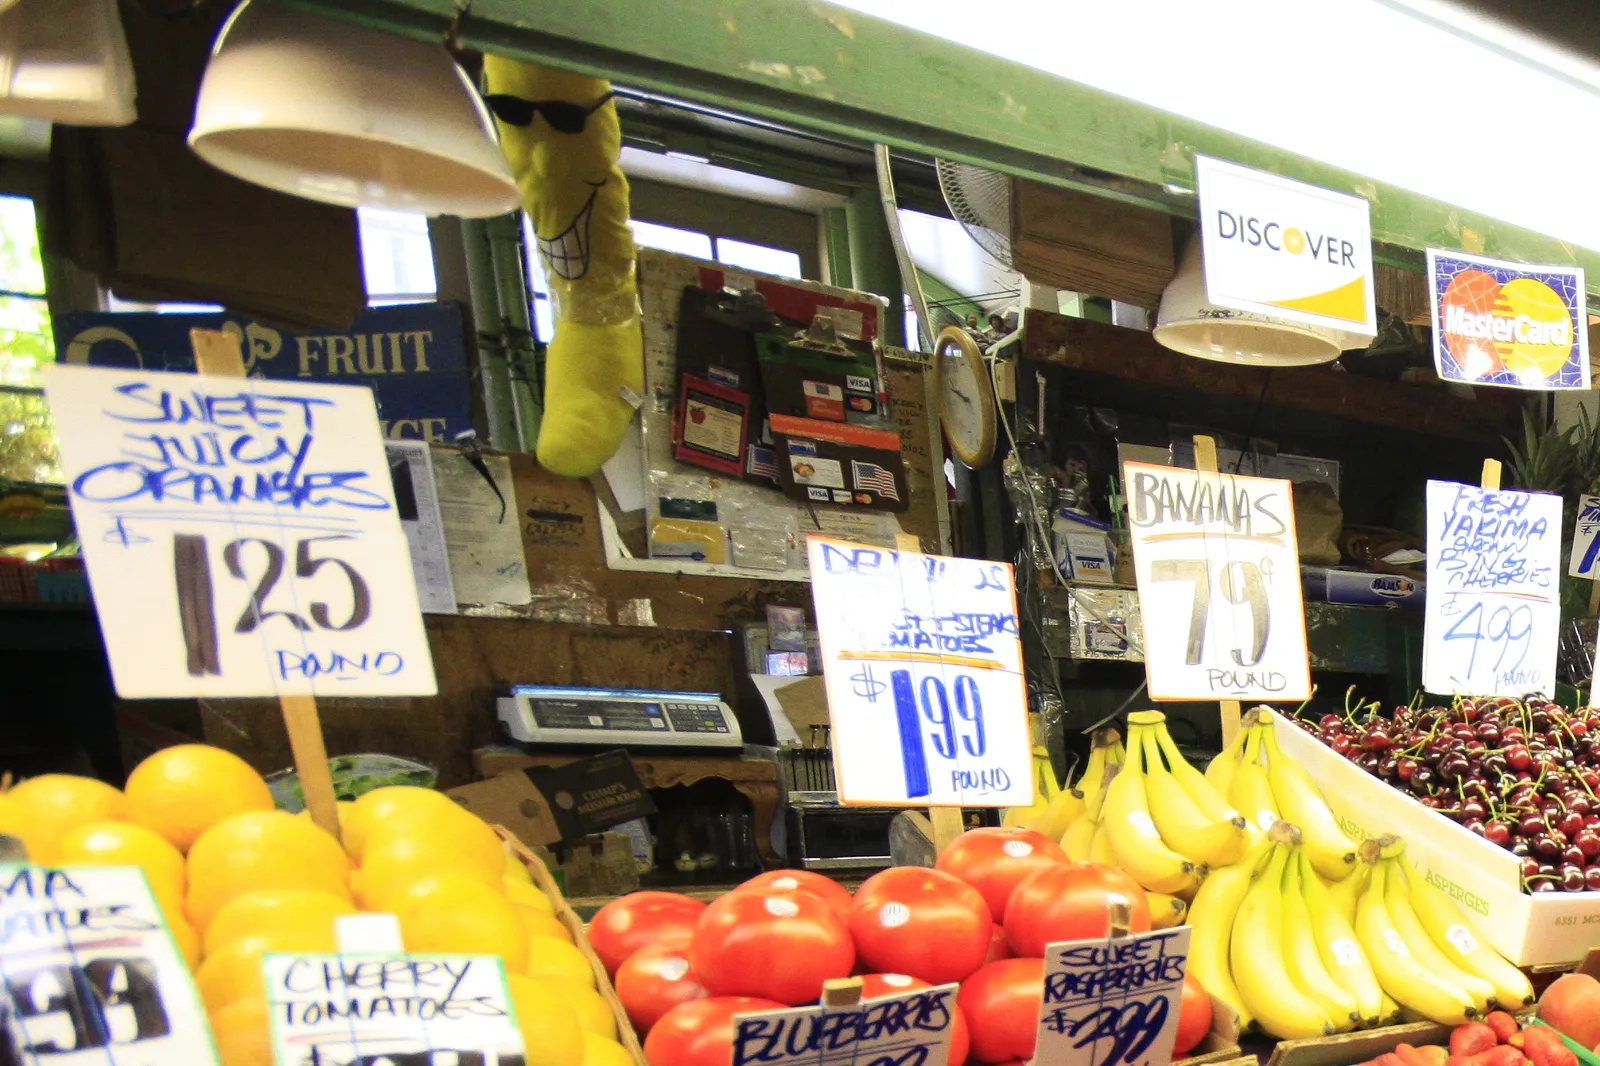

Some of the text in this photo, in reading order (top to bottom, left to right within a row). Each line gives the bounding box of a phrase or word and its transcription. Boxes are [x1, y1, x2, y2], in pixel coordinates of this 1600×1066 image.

[1217, 210, 1355, 271] DISCOVER
[1444, 305, 1570, 348] MasterCard
[296, 330, 433, 377] FRUIT
[102, 382, 337, 430] SWEET
[1131, 471, 1287, 537] BANANAS
[1440, 509, 1548, 541] YAKIMA
[277, 648, 404, 682] POUND
[1207, 668, 1287, 694] POUND
[952, 767, 1011, 794] POUND
[1424, 869, 1489, 916] ASPERGES
[1058, 932, 1178, 969] SWEET
[284, 960, 472, 1002] CHERRY
[284, 996, 508, 1026] TOMATOES
